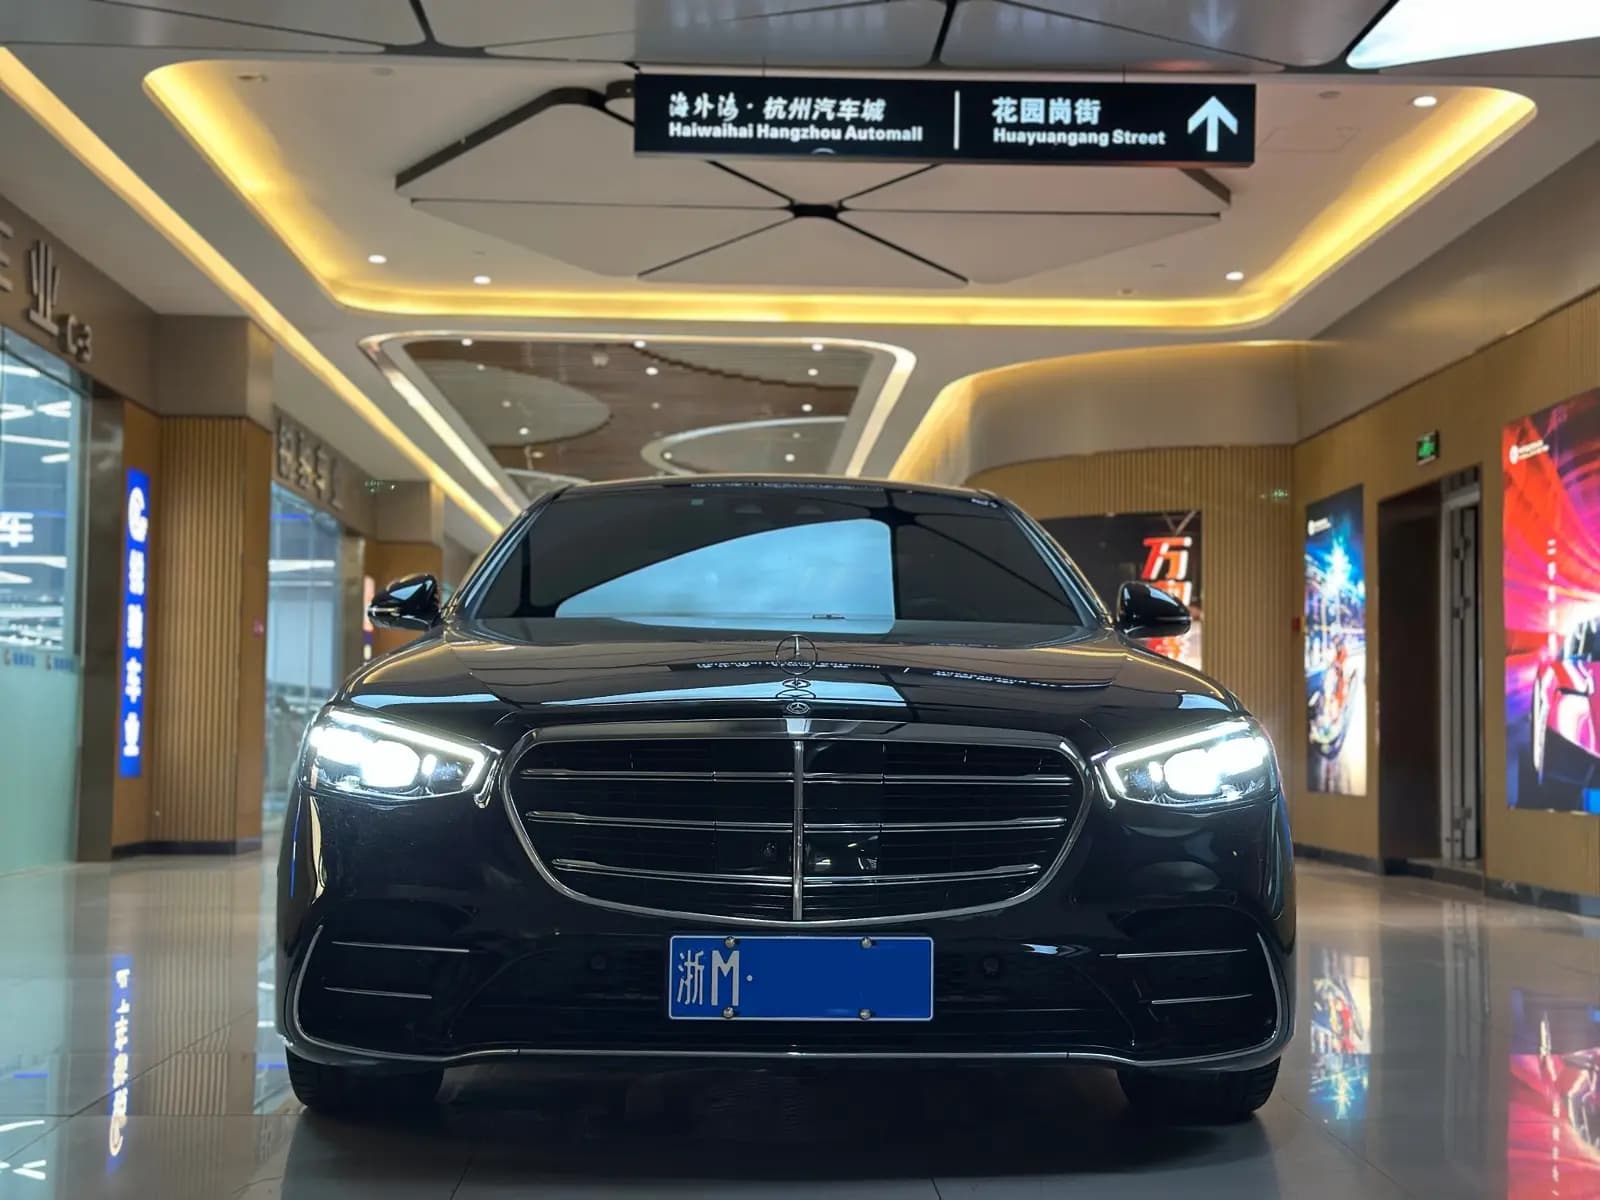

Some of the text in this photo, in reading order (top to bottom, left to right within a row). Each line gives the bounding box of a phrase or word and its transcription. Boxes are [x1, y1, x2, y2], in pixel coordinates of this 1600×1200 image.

[992, 96, 1101, 125] 花园岗街
[668, 122, 924, 143] Haiwaihai Hangzhou Automall
[993, 127, 1166, 147] Huayuangang Street
